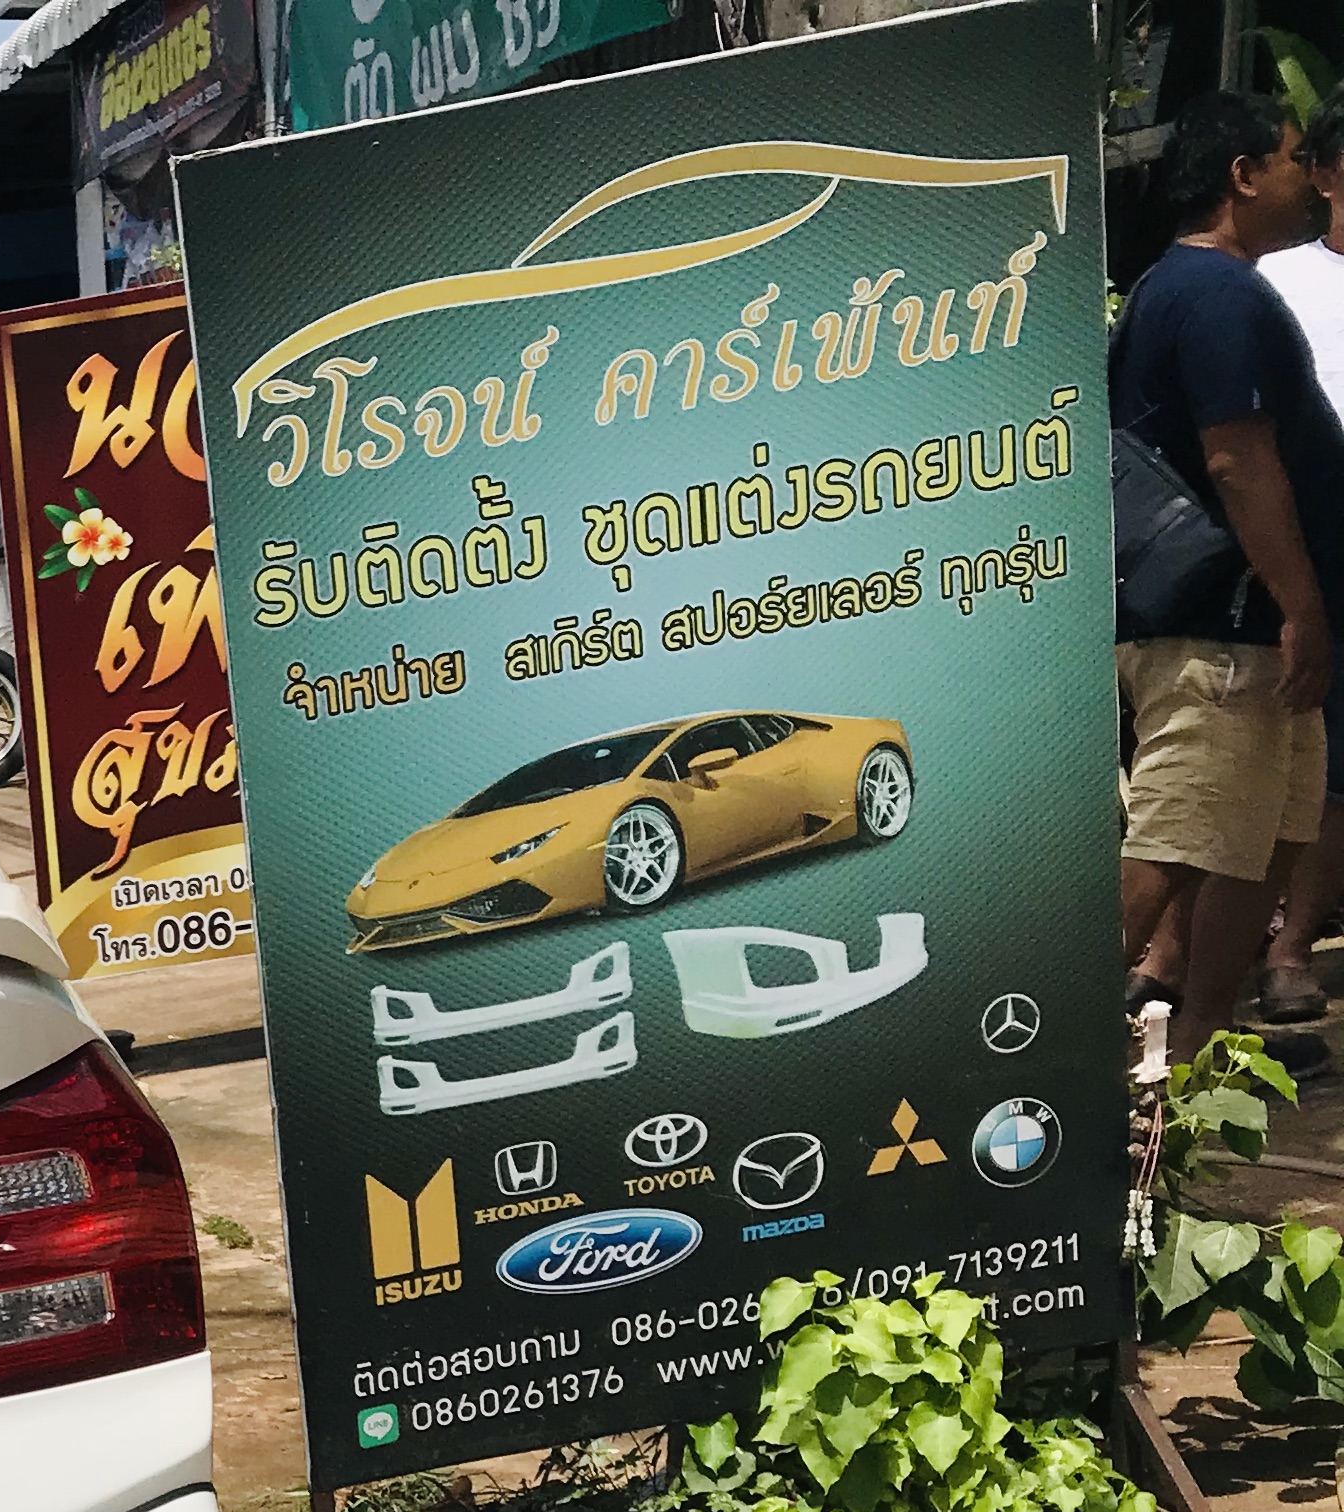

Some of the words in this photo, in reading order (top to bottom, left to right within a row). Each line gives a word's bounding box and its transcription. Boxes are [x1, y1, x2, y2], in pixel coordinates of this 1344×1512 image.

[259, 325, 560, 488] วิโรจน์
[595, 231, 1047, 425] คาร์เพ้นท์
[254, 475, 548, 628] รับติดตั้ง
[582, 386, 1080, 591] ชุดแต่งรถยนต์
[283, 645, 467, 721] จำหน่าย
[505, 609, 644, 681] สเกิร์ต
[941, 525, 1068, 615] ทุกรุ่น
[114, 875, 220, 908] เปิดเวลา
[229, 867, 249, 890] 0
[474, 1192, 585, 1226] HONDA
[624, 1165, 716, 1198] TOYOTA
[539, 1222, 661, 1283] Ford
[375, 1269, 462, 1308] ISUZU
[353, 1329, 582, 1399] ติดต่อสอบถาม
[412, 1366, 625, 1432] 0860261376
